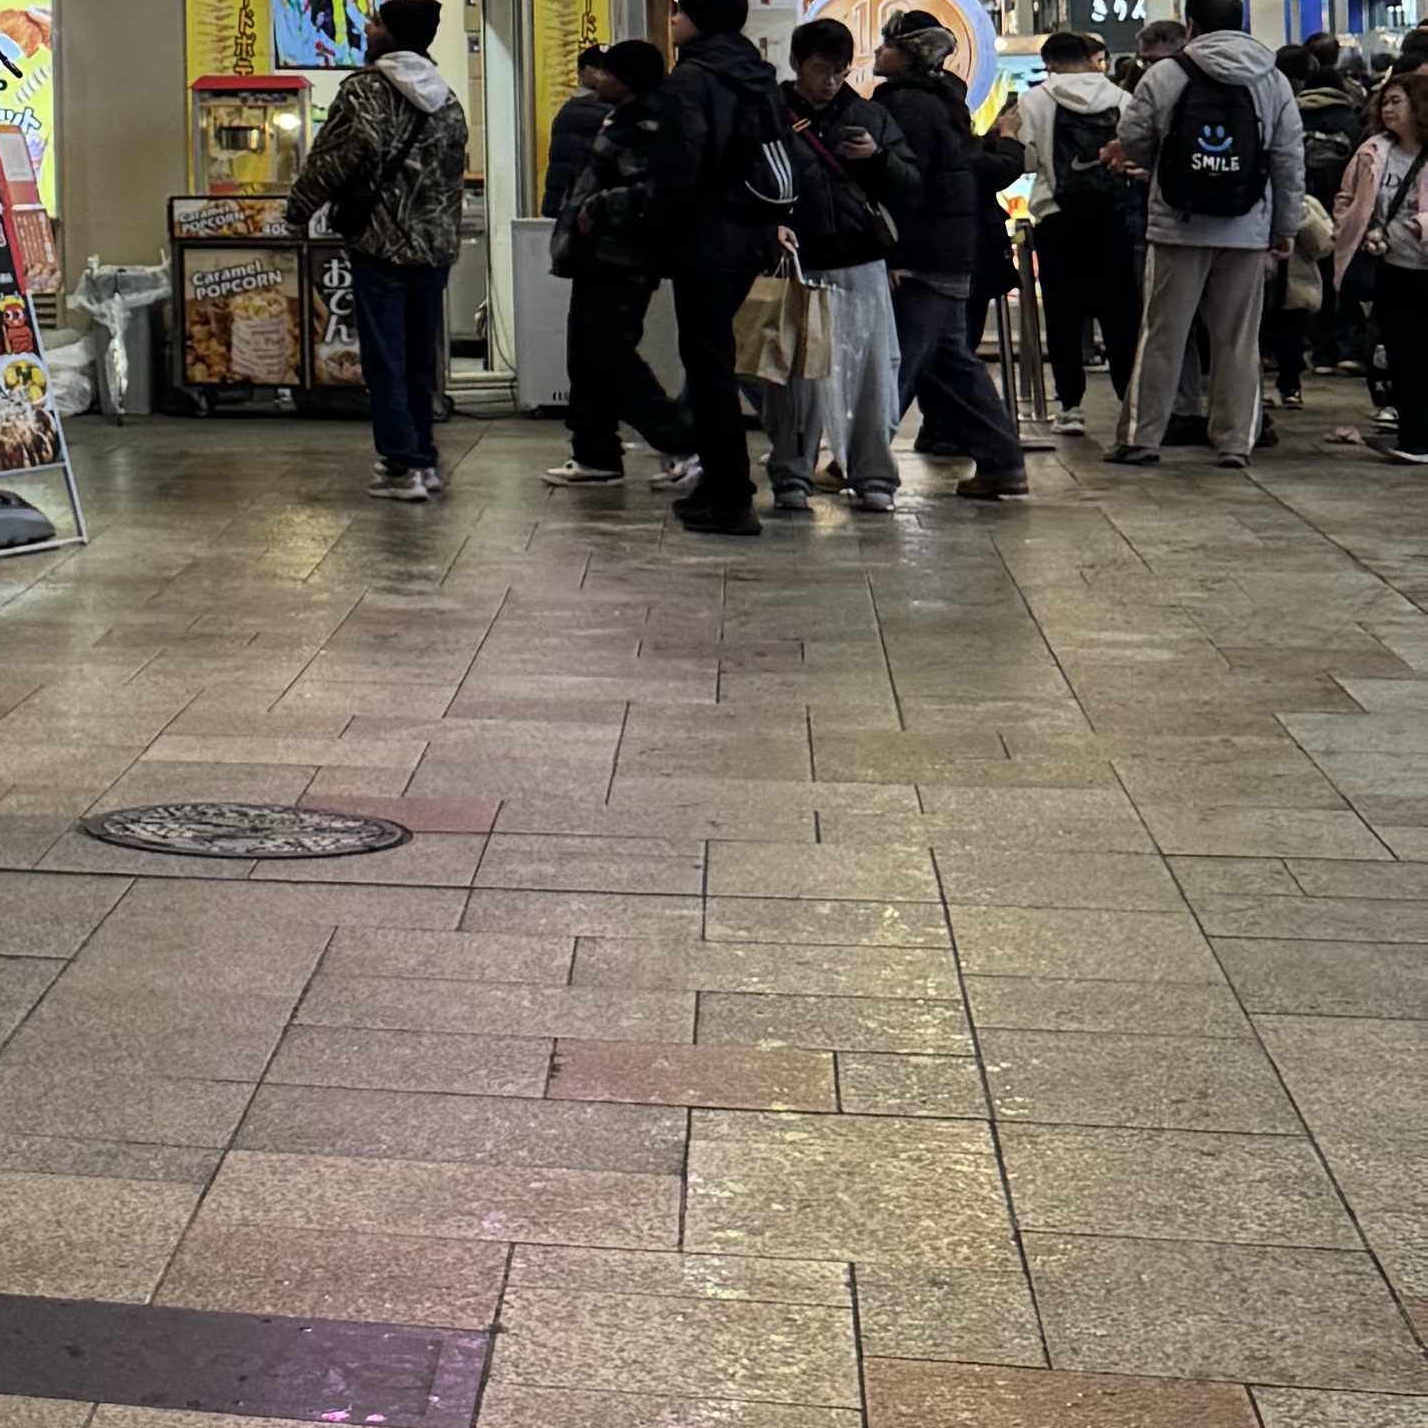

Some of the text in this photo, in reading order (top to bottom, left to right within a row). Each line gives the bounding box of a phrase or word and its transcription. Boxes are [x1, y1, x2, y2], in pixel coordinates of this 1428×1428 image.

[1191, 152, 1241, 173] SMILE
[178, 205, 231, 224] Caramel
[181, 211, 245, 236] POPCORN
[191, 259, 263, 288] Caramel
[195, 269, 284, 302] POPCORN
